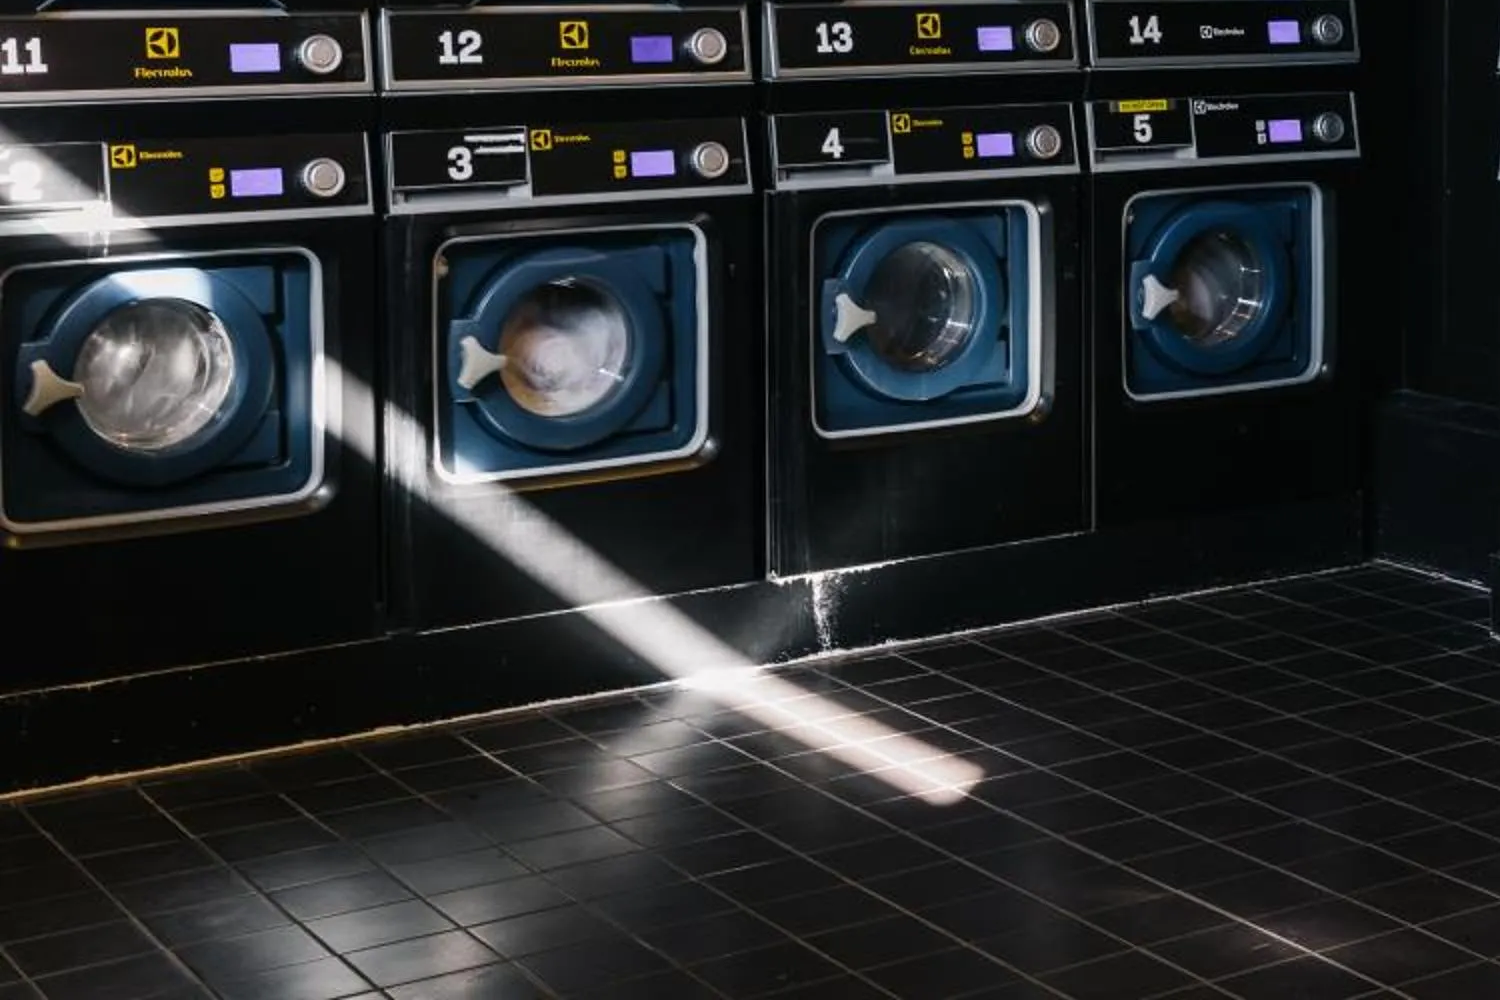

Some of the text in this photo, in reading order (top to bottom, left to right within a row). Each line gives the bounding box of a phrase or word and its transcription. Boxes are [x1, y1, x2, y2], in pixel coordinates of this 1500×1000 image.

[815, 21, 854, 53] 13
[1128, 15, 1163, 44] 14
[1, 37, 48, 75] 11
[438, 29, 483, 65] 12
[821, 127, 845, 159] 4
[1133, 113, 1153, 143] 5
[447, 146, 473, 181] 3
